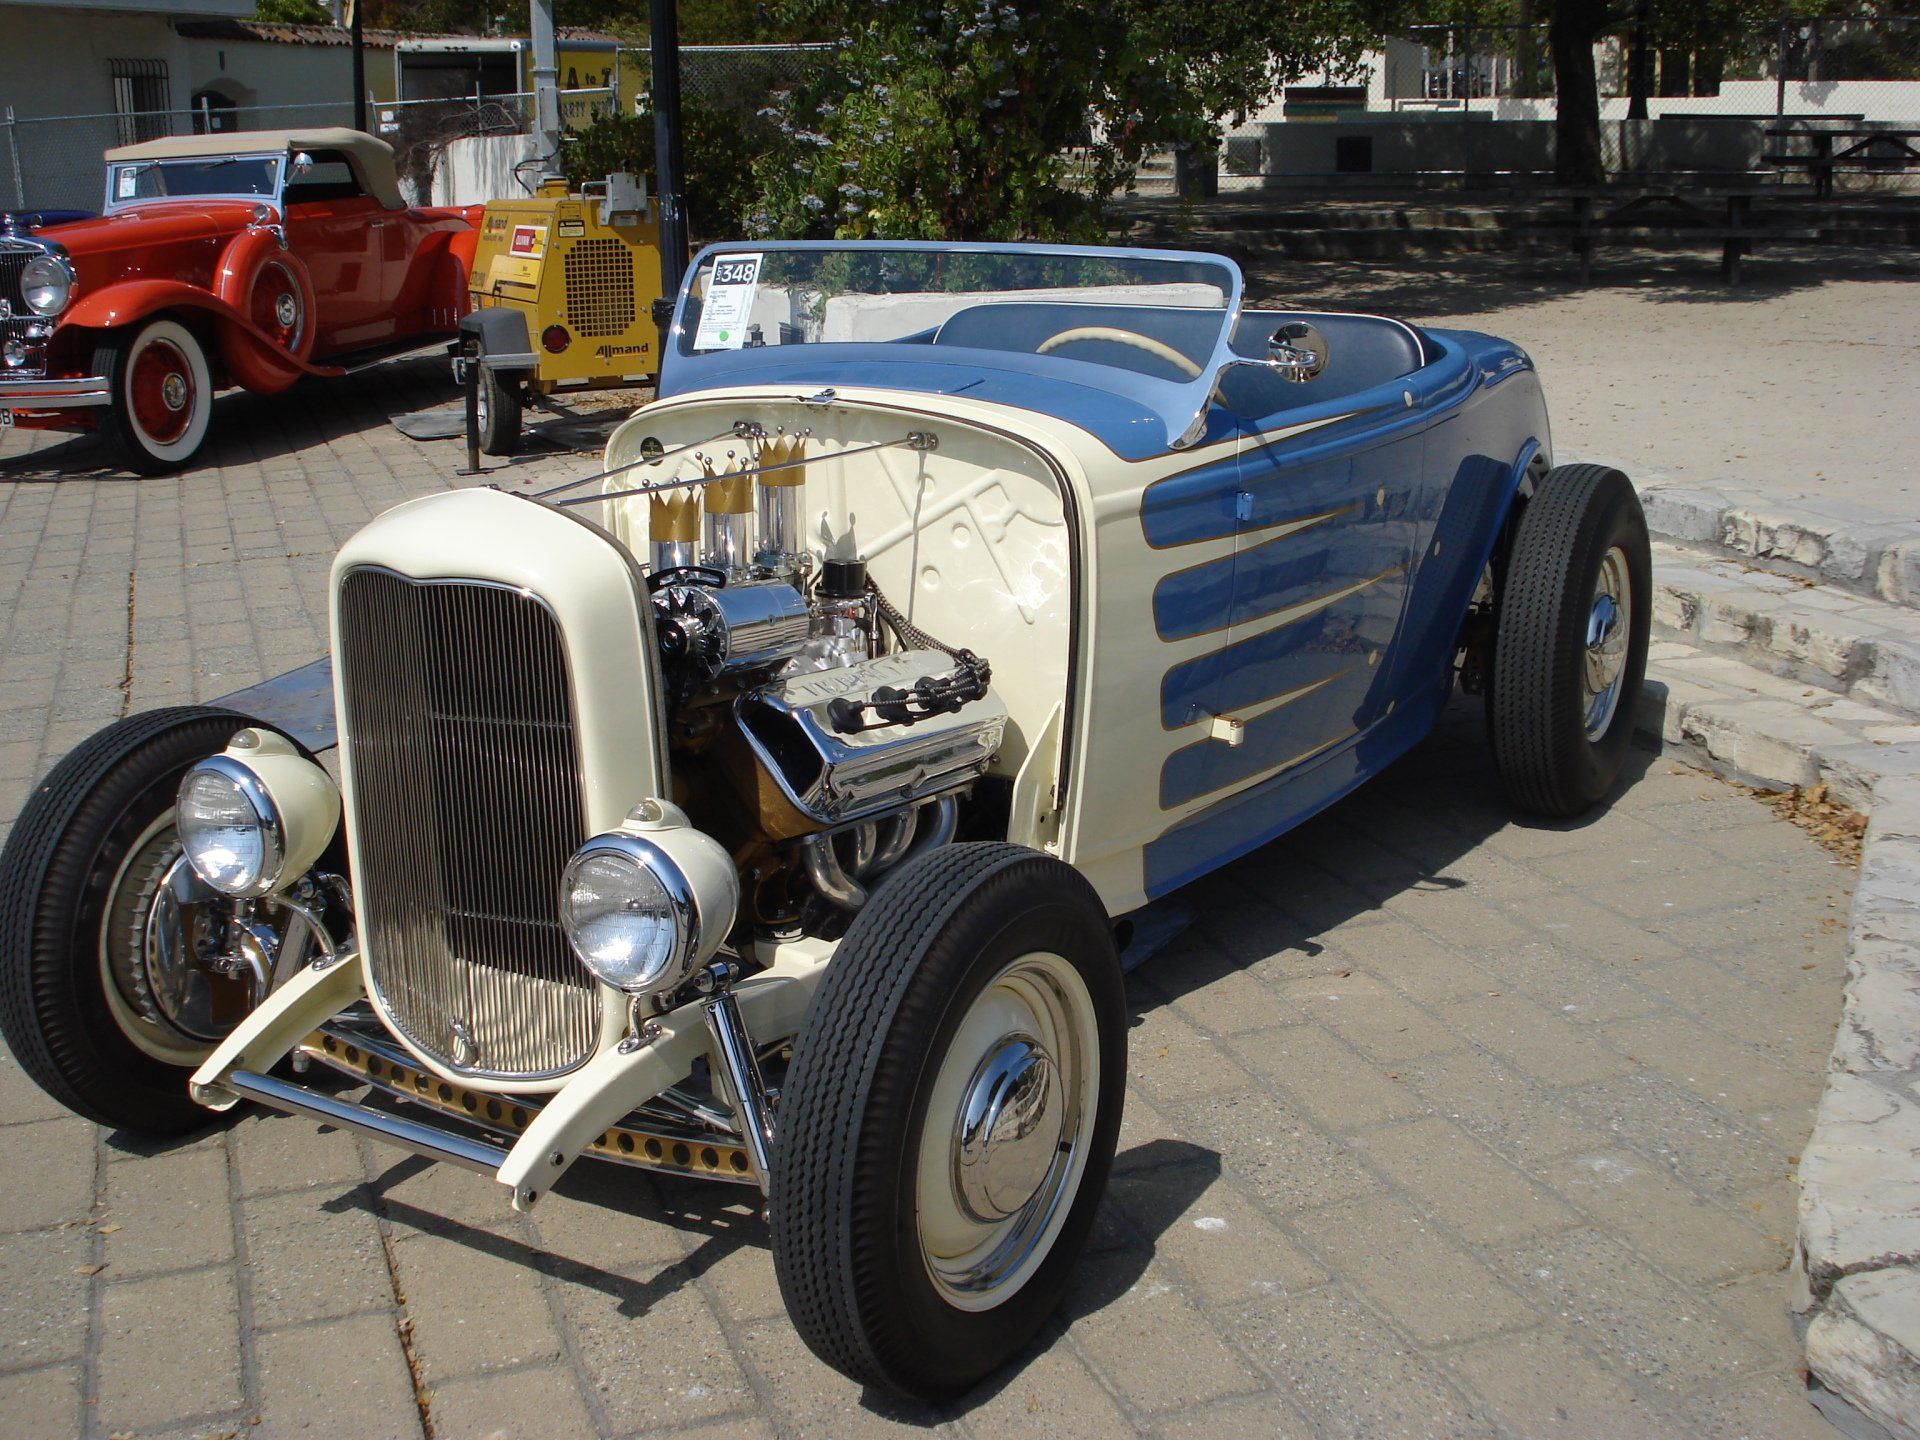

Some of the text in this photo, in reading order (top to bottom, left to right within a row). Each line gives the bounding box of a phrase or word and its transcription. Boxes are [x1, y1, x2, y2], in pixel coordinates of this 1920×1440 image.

[567, 67, 580, 89] A
[585, 73, 597, 85] to
[721, 263, 755, 283] 348
[595, 342, 649, 357] Allmand
